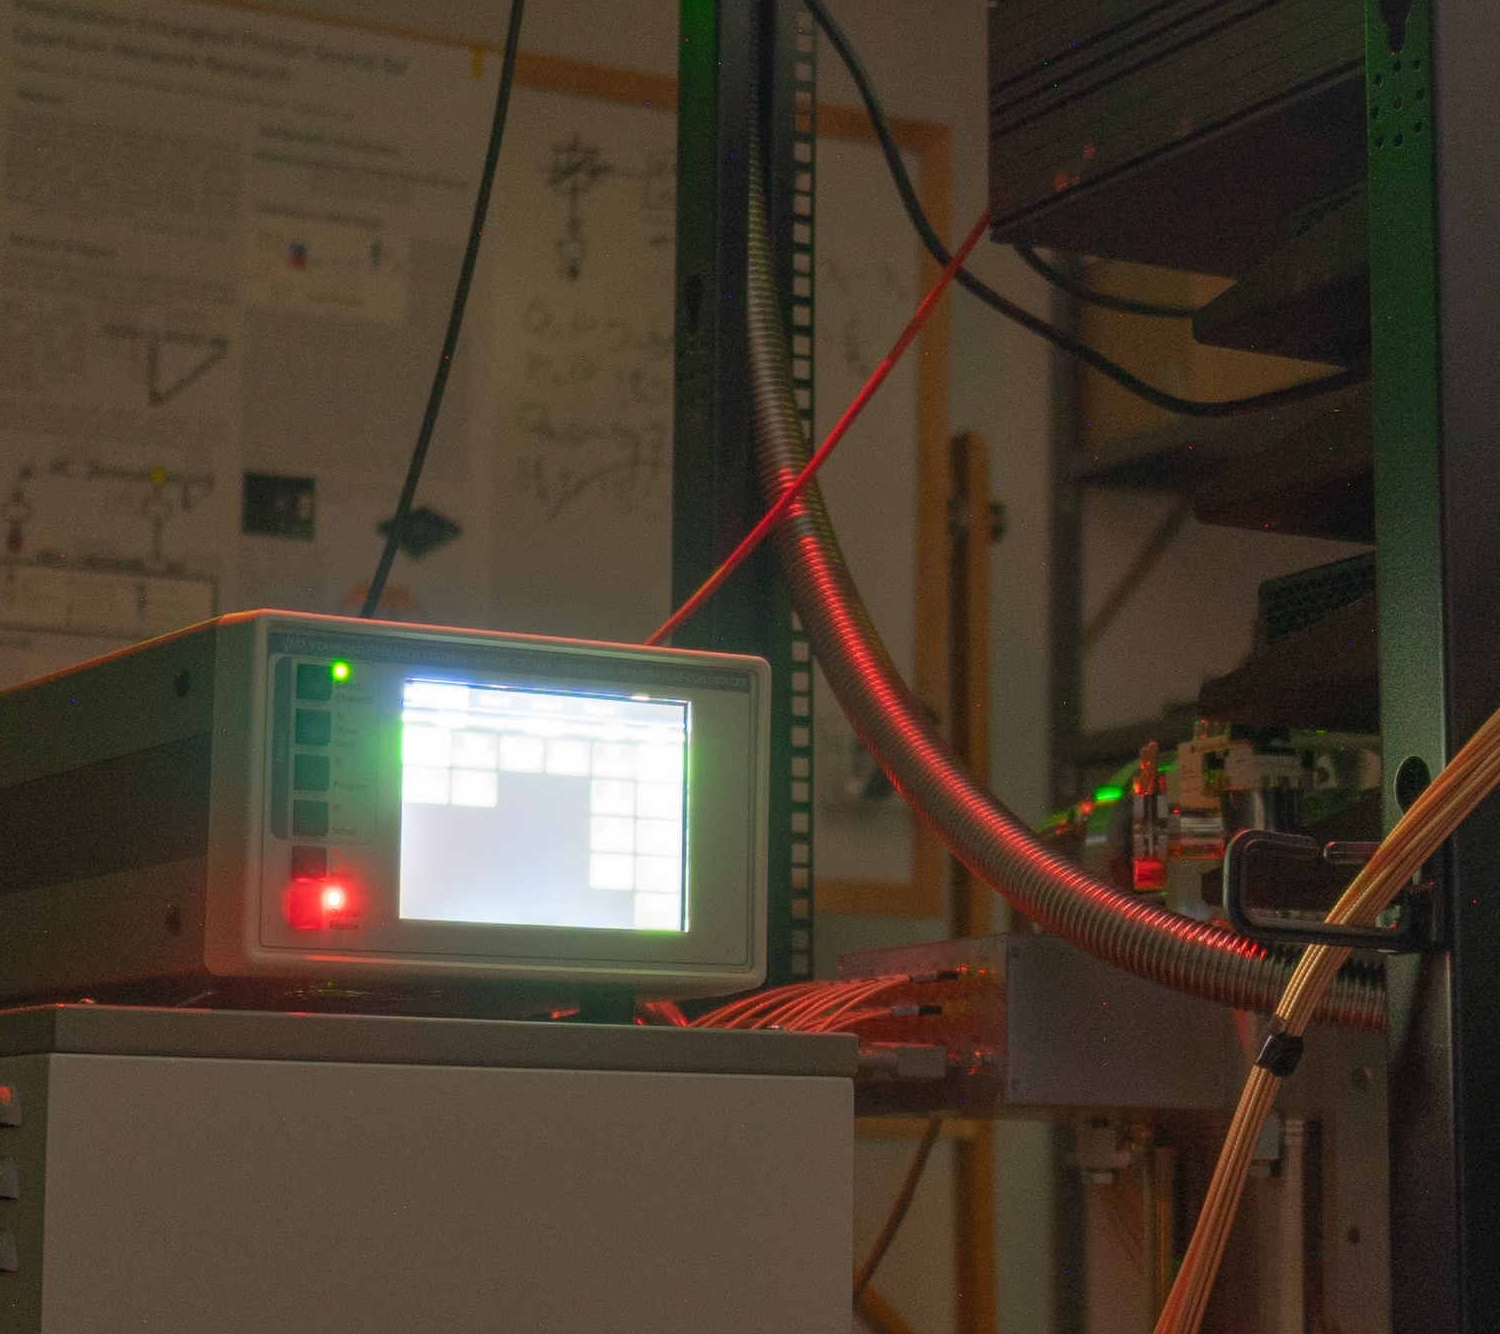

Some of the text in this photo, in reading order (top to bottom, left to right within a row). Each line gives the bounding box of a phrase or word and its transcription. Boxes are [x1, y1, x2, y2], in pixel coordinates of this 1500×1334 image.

[311, 641, 366, 654] STANFORD
[423, 651, 467, 664] SYSTEMS
[618, 667, 685, 681] TEMPERATURE
[688, 672, 748, 687] CONTROLLER
[332, 826, 357, 837] Setup
